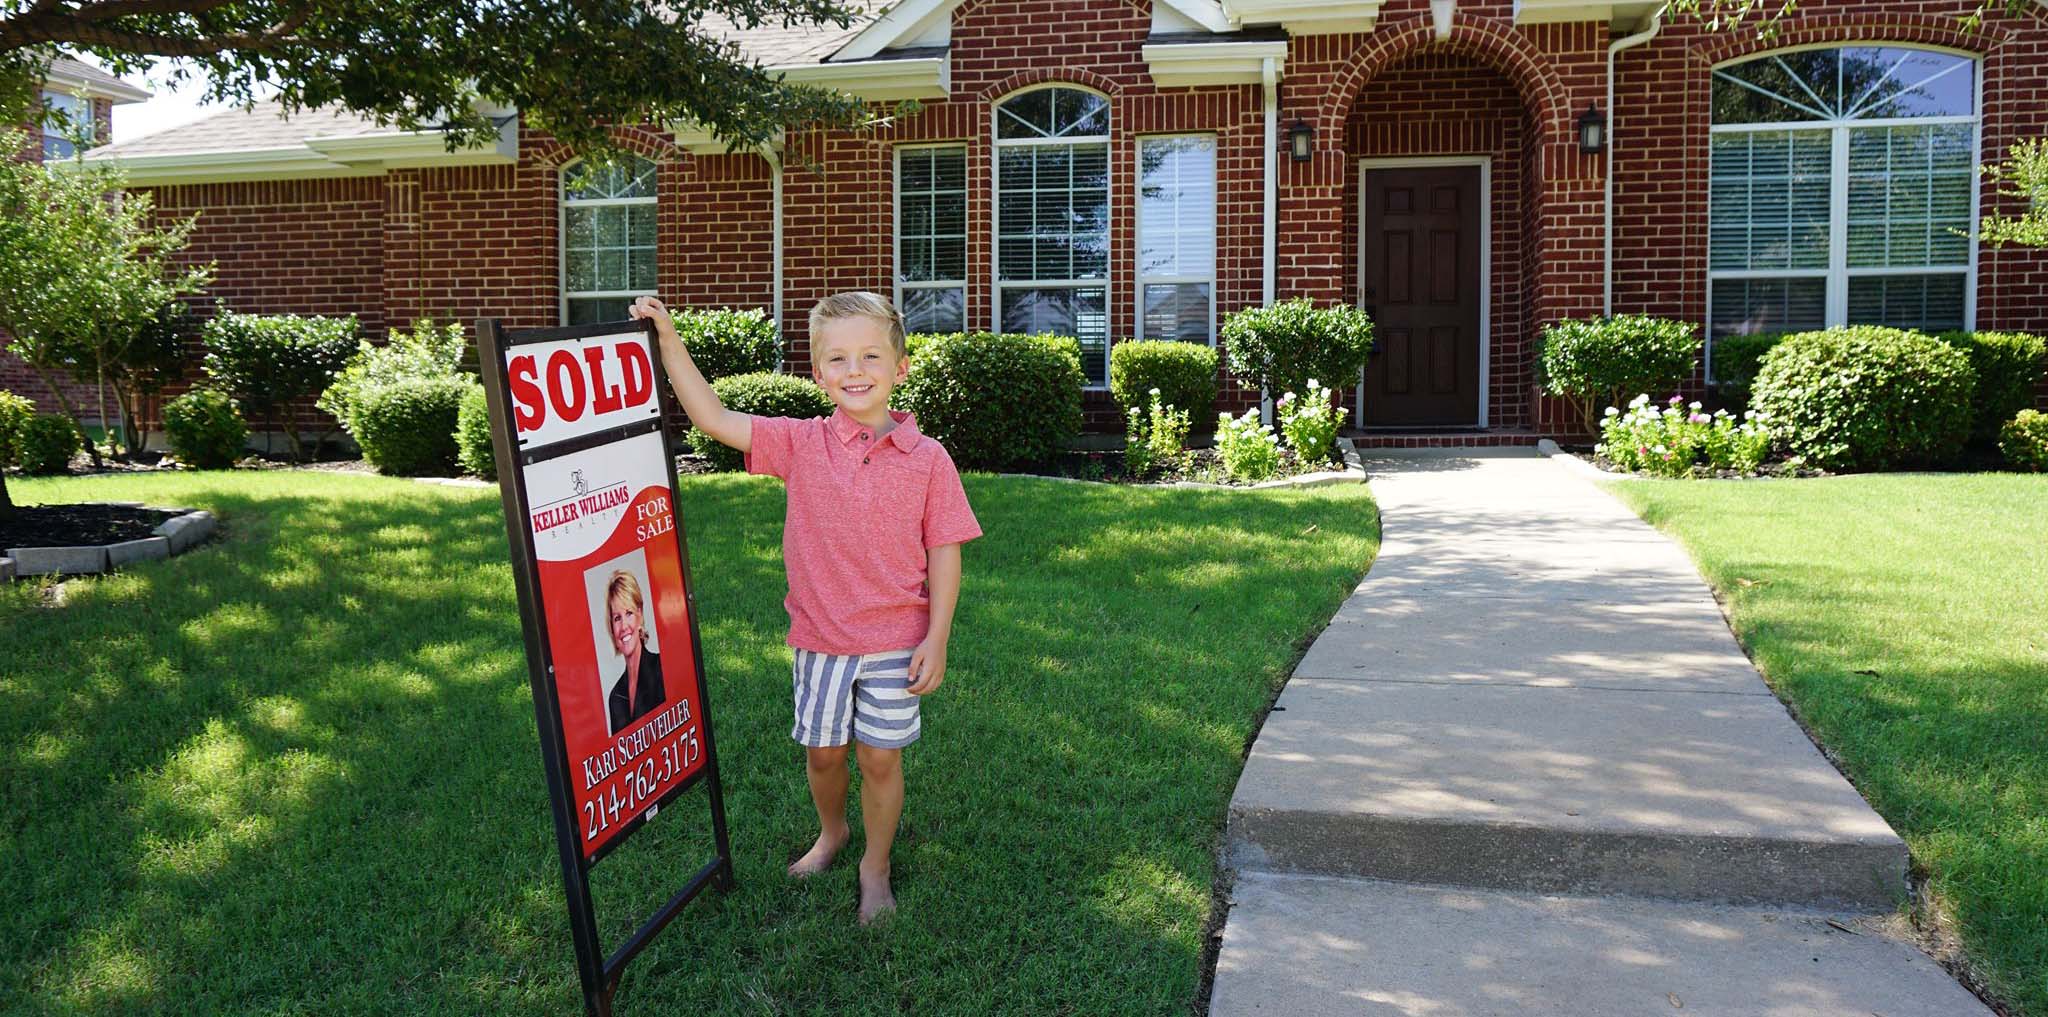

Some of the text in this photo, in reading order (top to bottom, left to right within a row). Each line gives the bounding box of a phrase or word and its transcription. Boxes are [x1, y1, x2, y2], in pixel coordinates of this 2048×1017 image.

[508, 342, 652, 432] SOLD
[532, 486, 629, 533] KELLER WILLIAMS
[636, 497, 668, 521] FOR
[636, 515, 674, 542] SALE
[584, 726, 698, 840] 214-762-3175
